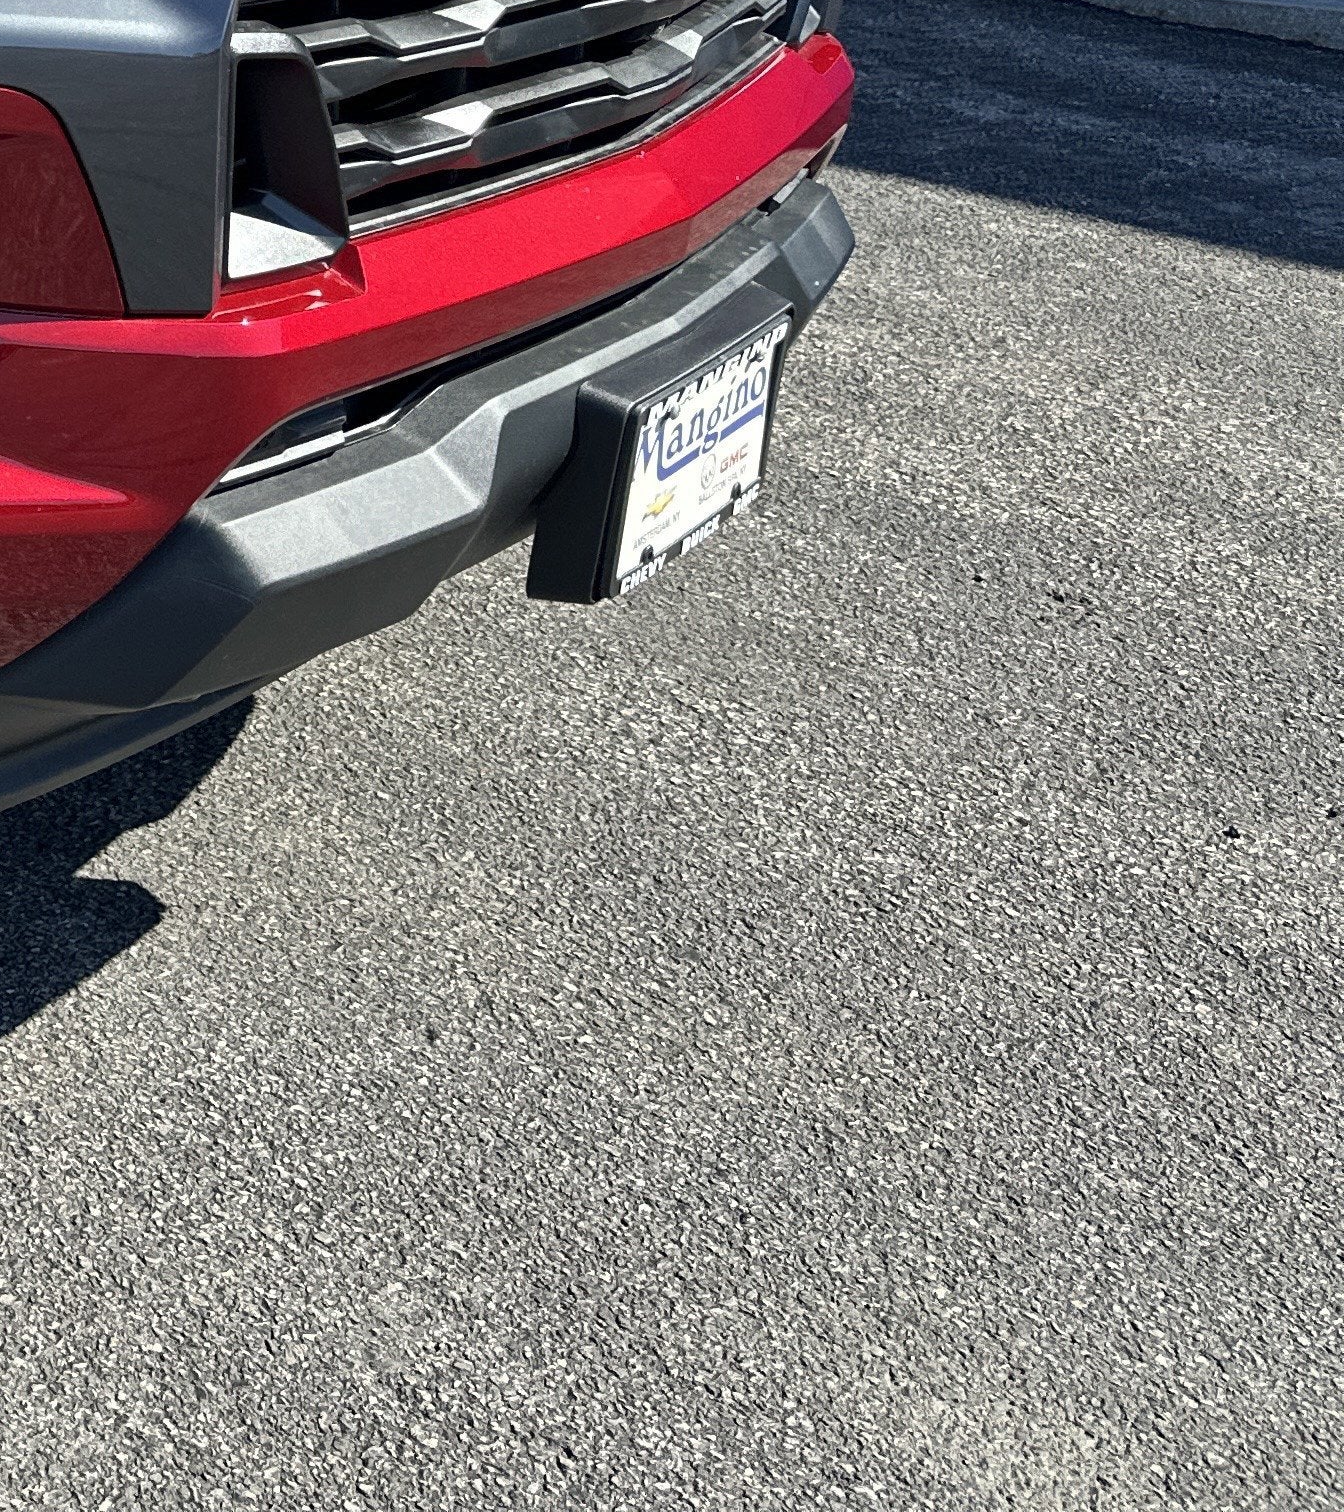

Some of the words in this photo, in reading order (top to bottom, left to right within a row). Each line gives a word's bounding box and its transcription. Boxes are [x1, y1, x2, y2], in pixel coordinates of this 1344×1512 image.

[633, 366, 767, 482] Mangino
[643, 323, 789, 428] MANGINO
[719, 442, 750, 474] GMC
[620, 552, 667, 595] CHEVY
[680, 514, 721, 556] BUICK
[732, 484, 760, 516] GMC
